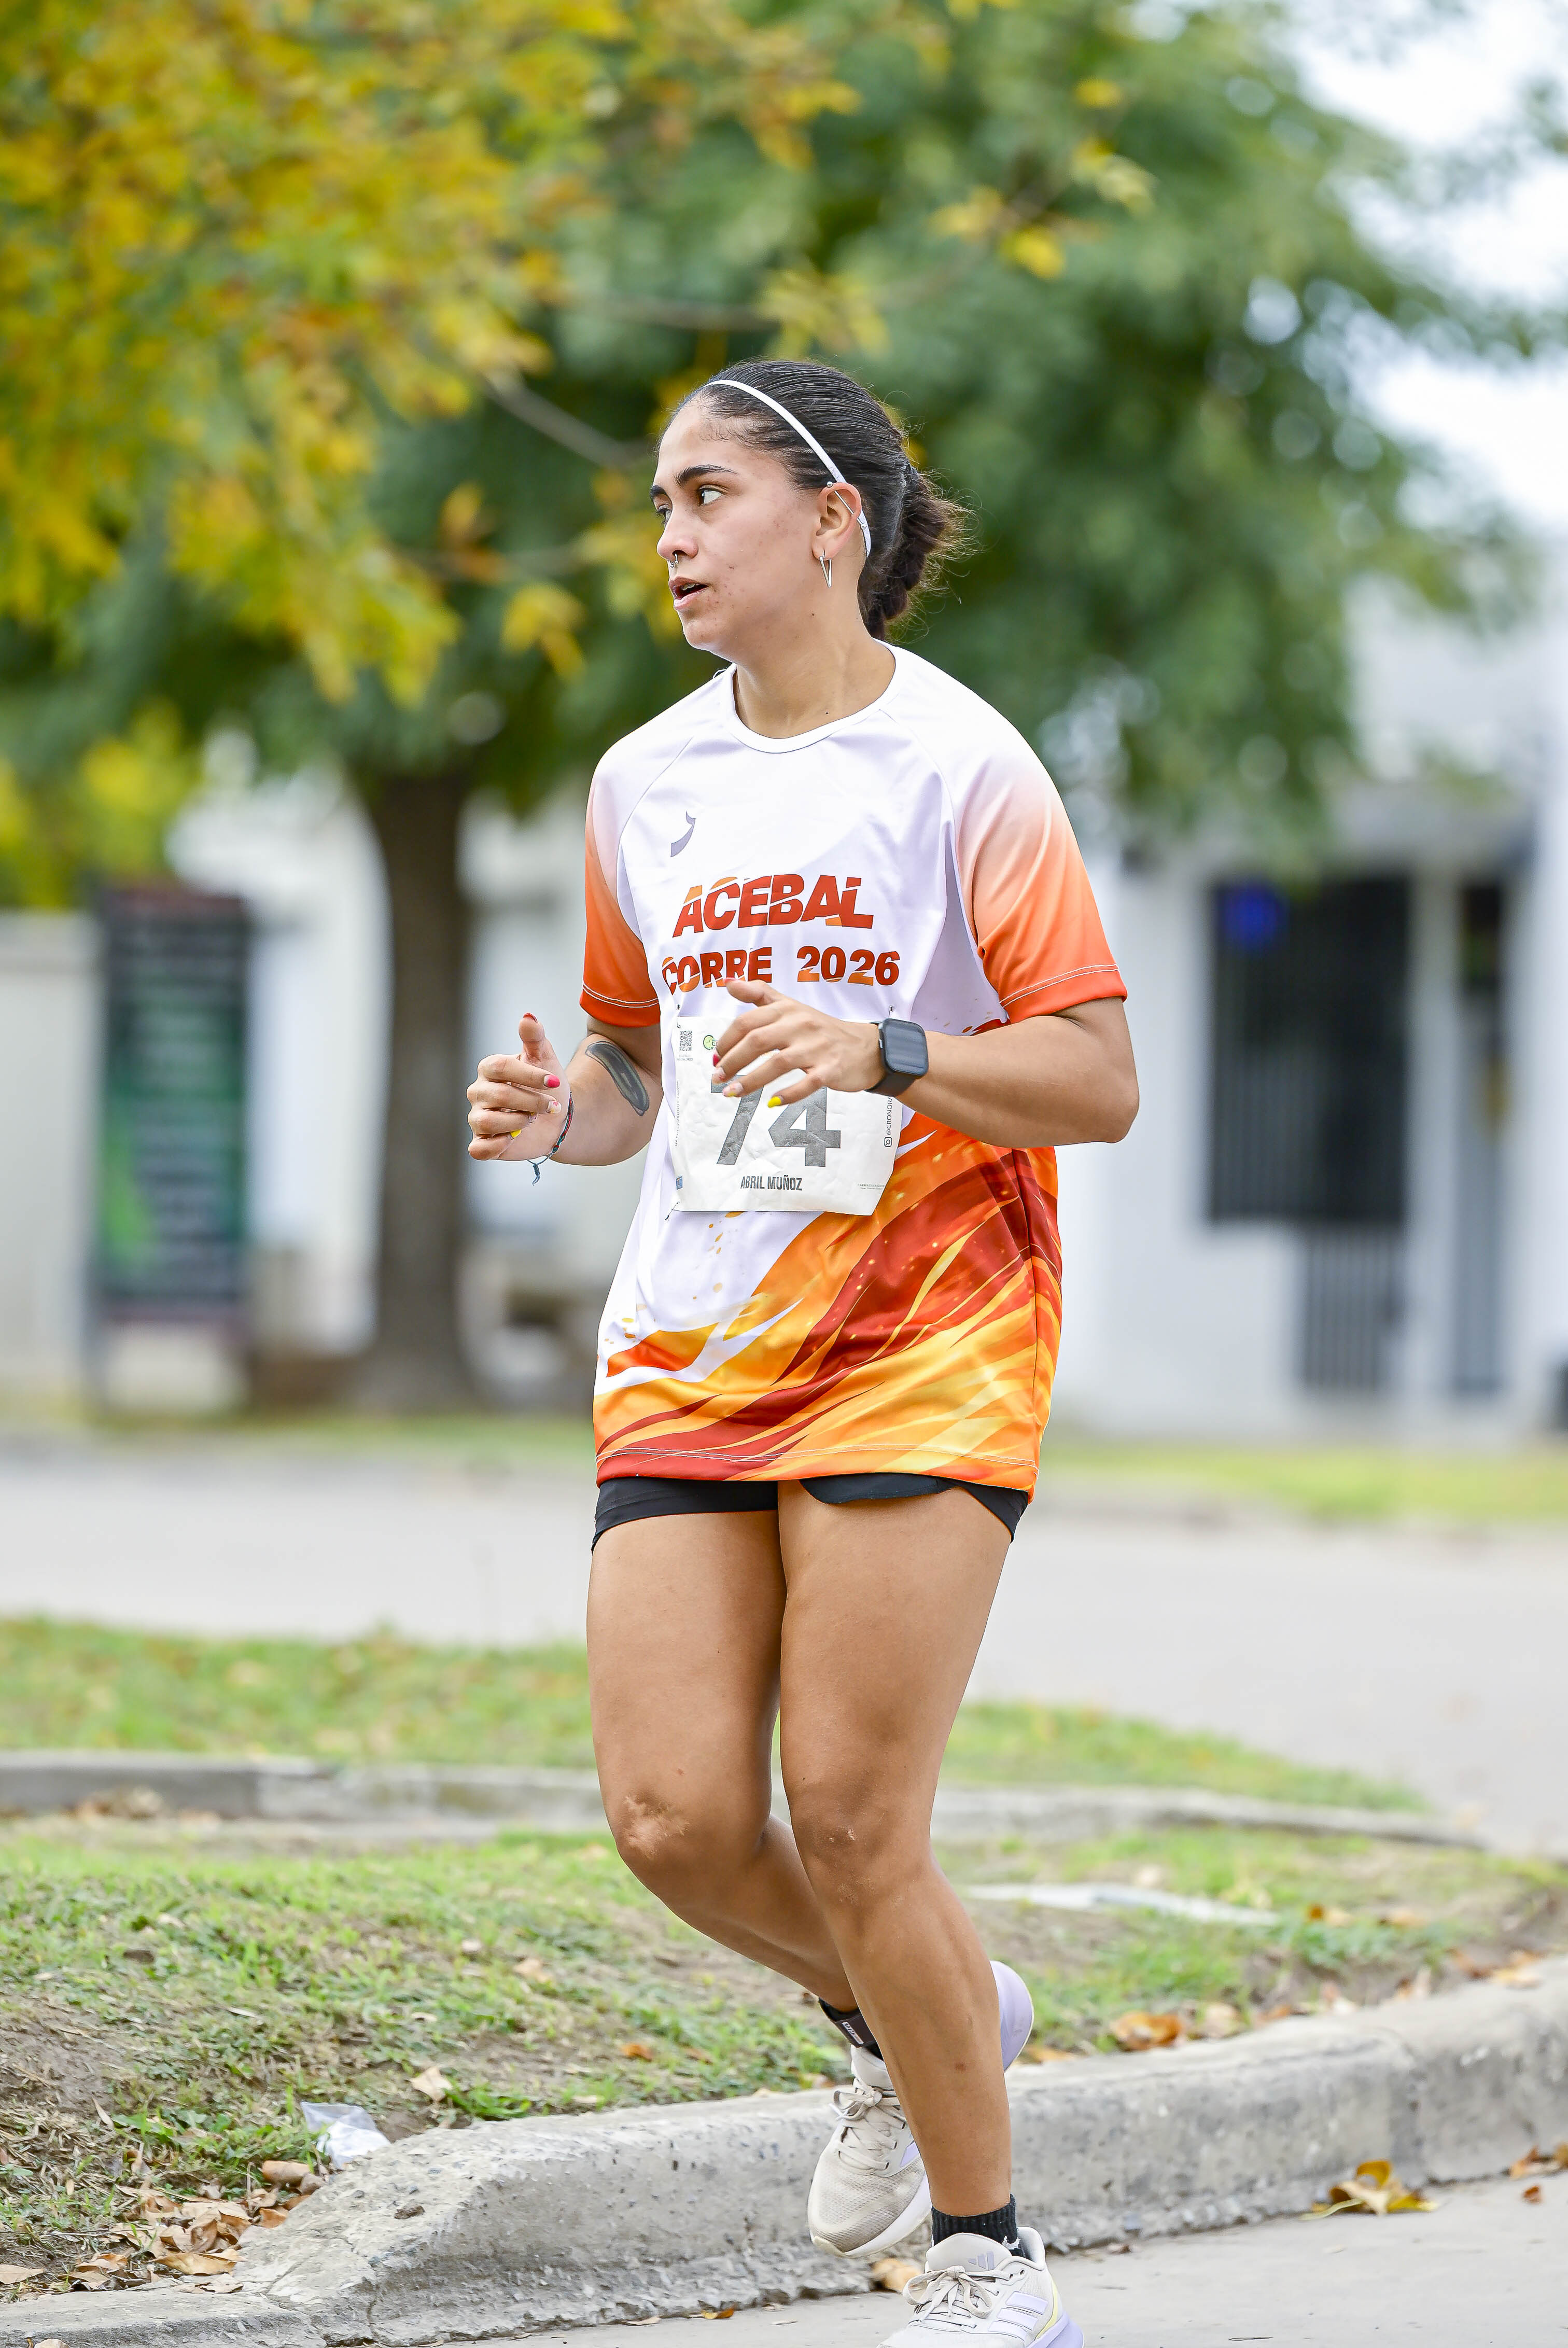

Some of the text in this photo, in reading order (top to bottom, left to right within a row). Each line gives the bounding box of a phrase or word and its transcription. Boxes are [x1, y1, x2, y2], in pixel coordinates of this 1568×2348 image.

[673, 874, 874, 938] ACEBAL
[662, 945, 901, 996] CORRE 2026
[711, 1074, 841, 1167] 74
[740, 1175, 802, 1191] ABRIL MUÑOZ
